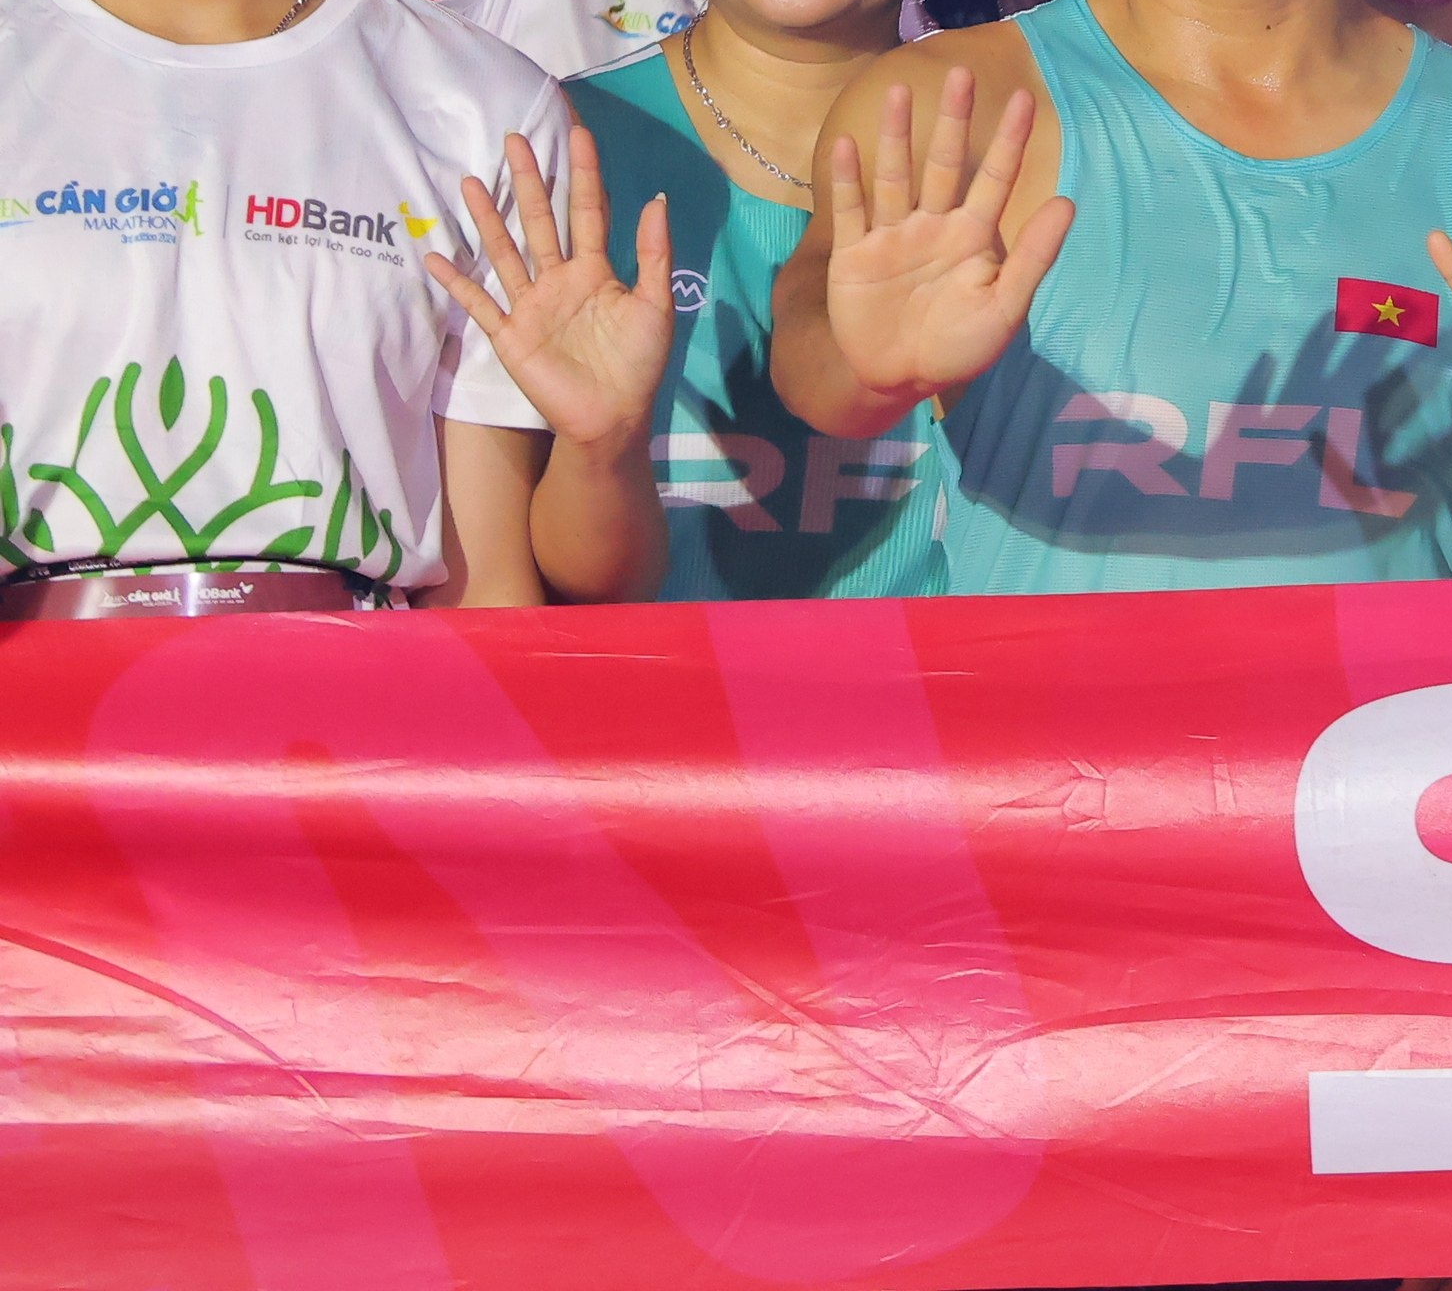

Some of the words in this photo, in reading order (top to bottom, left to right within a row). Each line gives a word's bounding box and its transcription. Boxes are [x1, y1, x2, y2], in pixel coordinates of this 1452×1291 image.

[36, 181, 106, 215] CẦN
[115, 181, 178, 214] GIỜ
[84, 215, 177, 231] MARATHON
[244, 230, 272, 242] Cam
[246, 194, 398, 248] HDBank
[1052, 391, 1419, 518] RFL
[648, 432, 933, 534] RF
